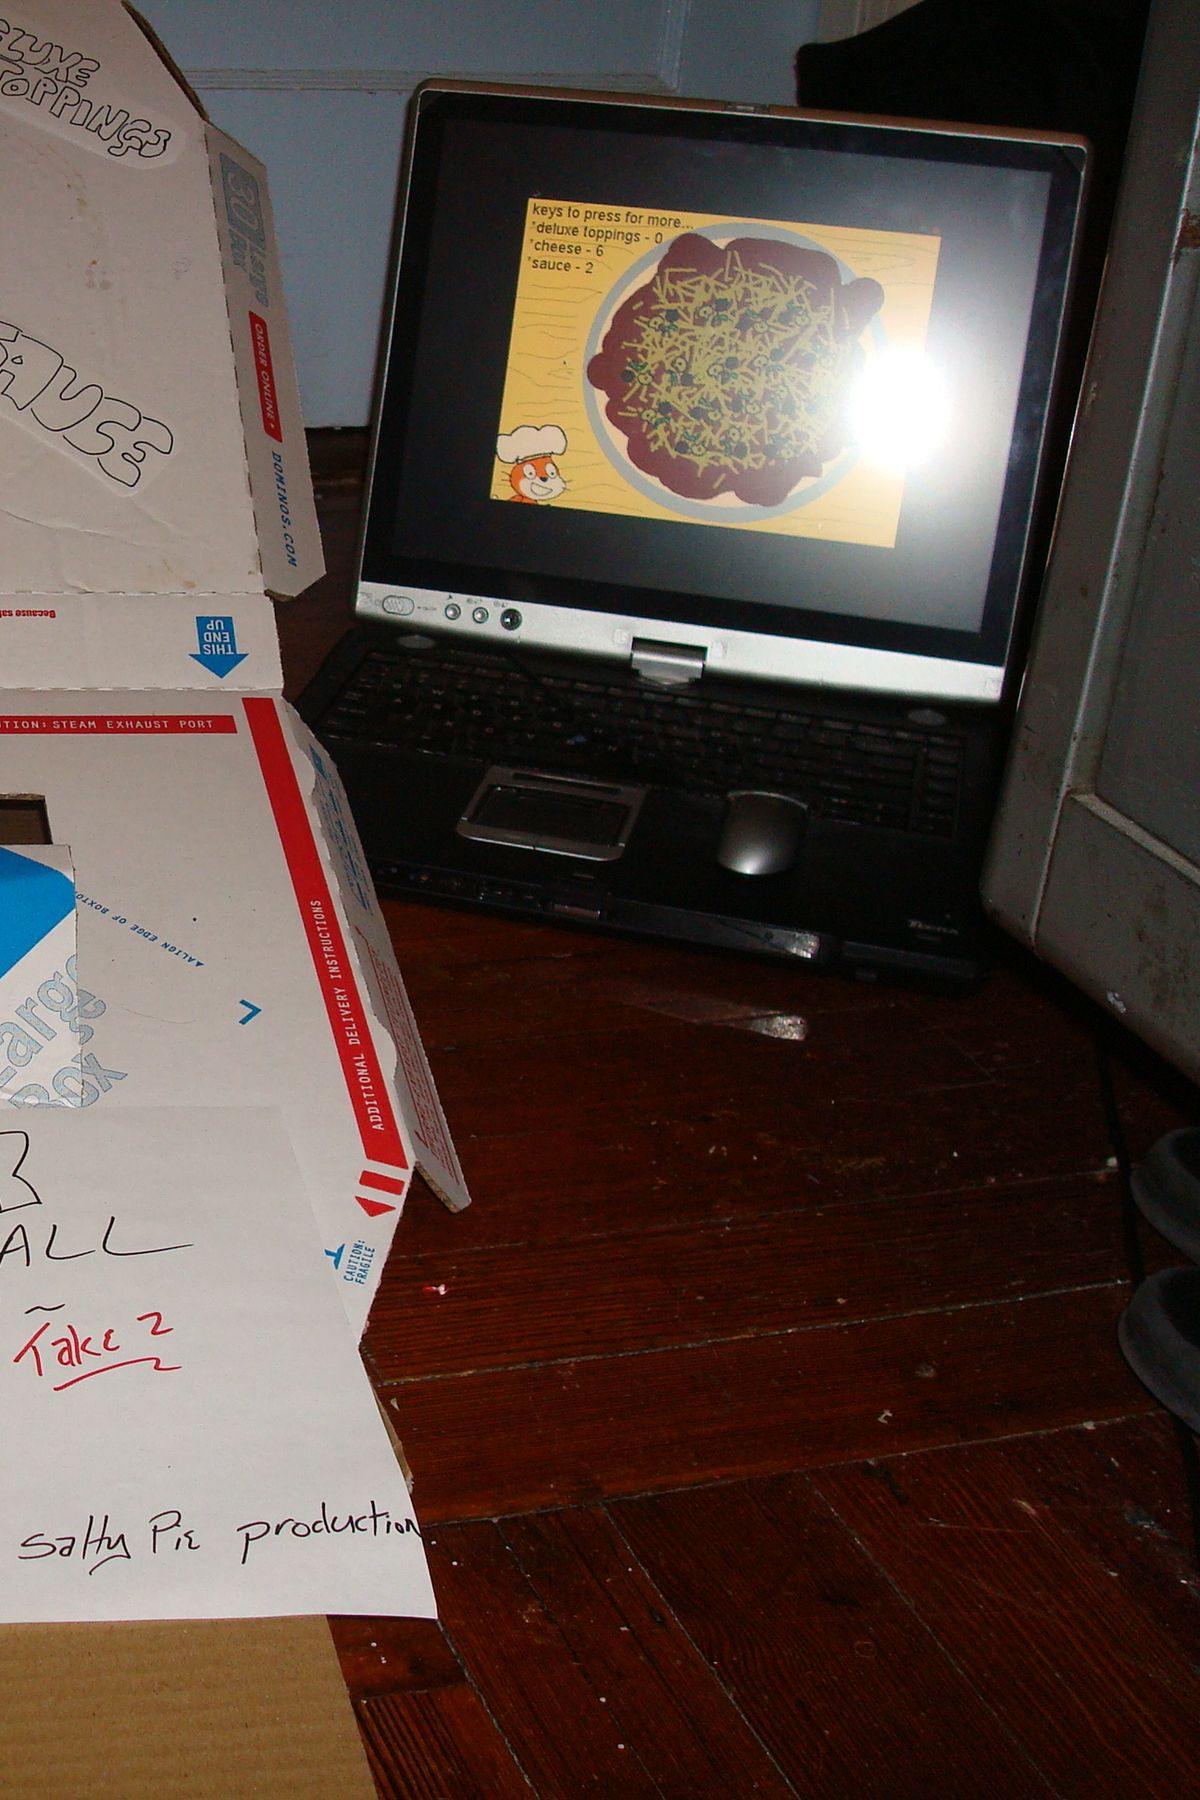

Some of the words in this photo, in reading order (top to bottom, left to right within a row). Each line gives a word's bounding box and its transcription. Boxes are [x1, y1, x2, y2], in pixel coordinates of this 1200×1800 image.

[532, 203, 563, 219] keys
[568, 206, 580, 218] to
[584, 209, 621, 222] press
[625, 211, 644, 224] for
[583, 225, 640, 245] toppings
[596, 244, 604, 256] 6
[585, 262, 594, 274] 2
[255, 324, 268, 367] ORDER
[260, 369, 274, 423] ONLINE
[272, 451, 297, 567] DOMINOS.COM
[15, 609, 56, 619] Because
[206, 619, 225, 630] UP
[203, 632, 230, 643] END
[203, 644, 235, 655] THIS
[106, 719, 169, 729] EXHAUST
[179, 719, 214, 729] PORT
[75, 891, 109, 914] BOXTO
[112, 915, 127, 924] OF
[130, 924, 158, 942] EDGE
[310, 899, 342, 979] INSTRUCTIONS
[161, 942, 196, 963] ALIGN
[334, 987, 361, 1046] DELIVERY
[348, 1053, 385, 1131] ADDITIONAL
[343, 1238, 367, 1283] CAUTION:
[355, 1245, 375, 1285] FRAGILE
[136, 1311, 174, 1339] 2
[236, 1500, 424, 1565] production
